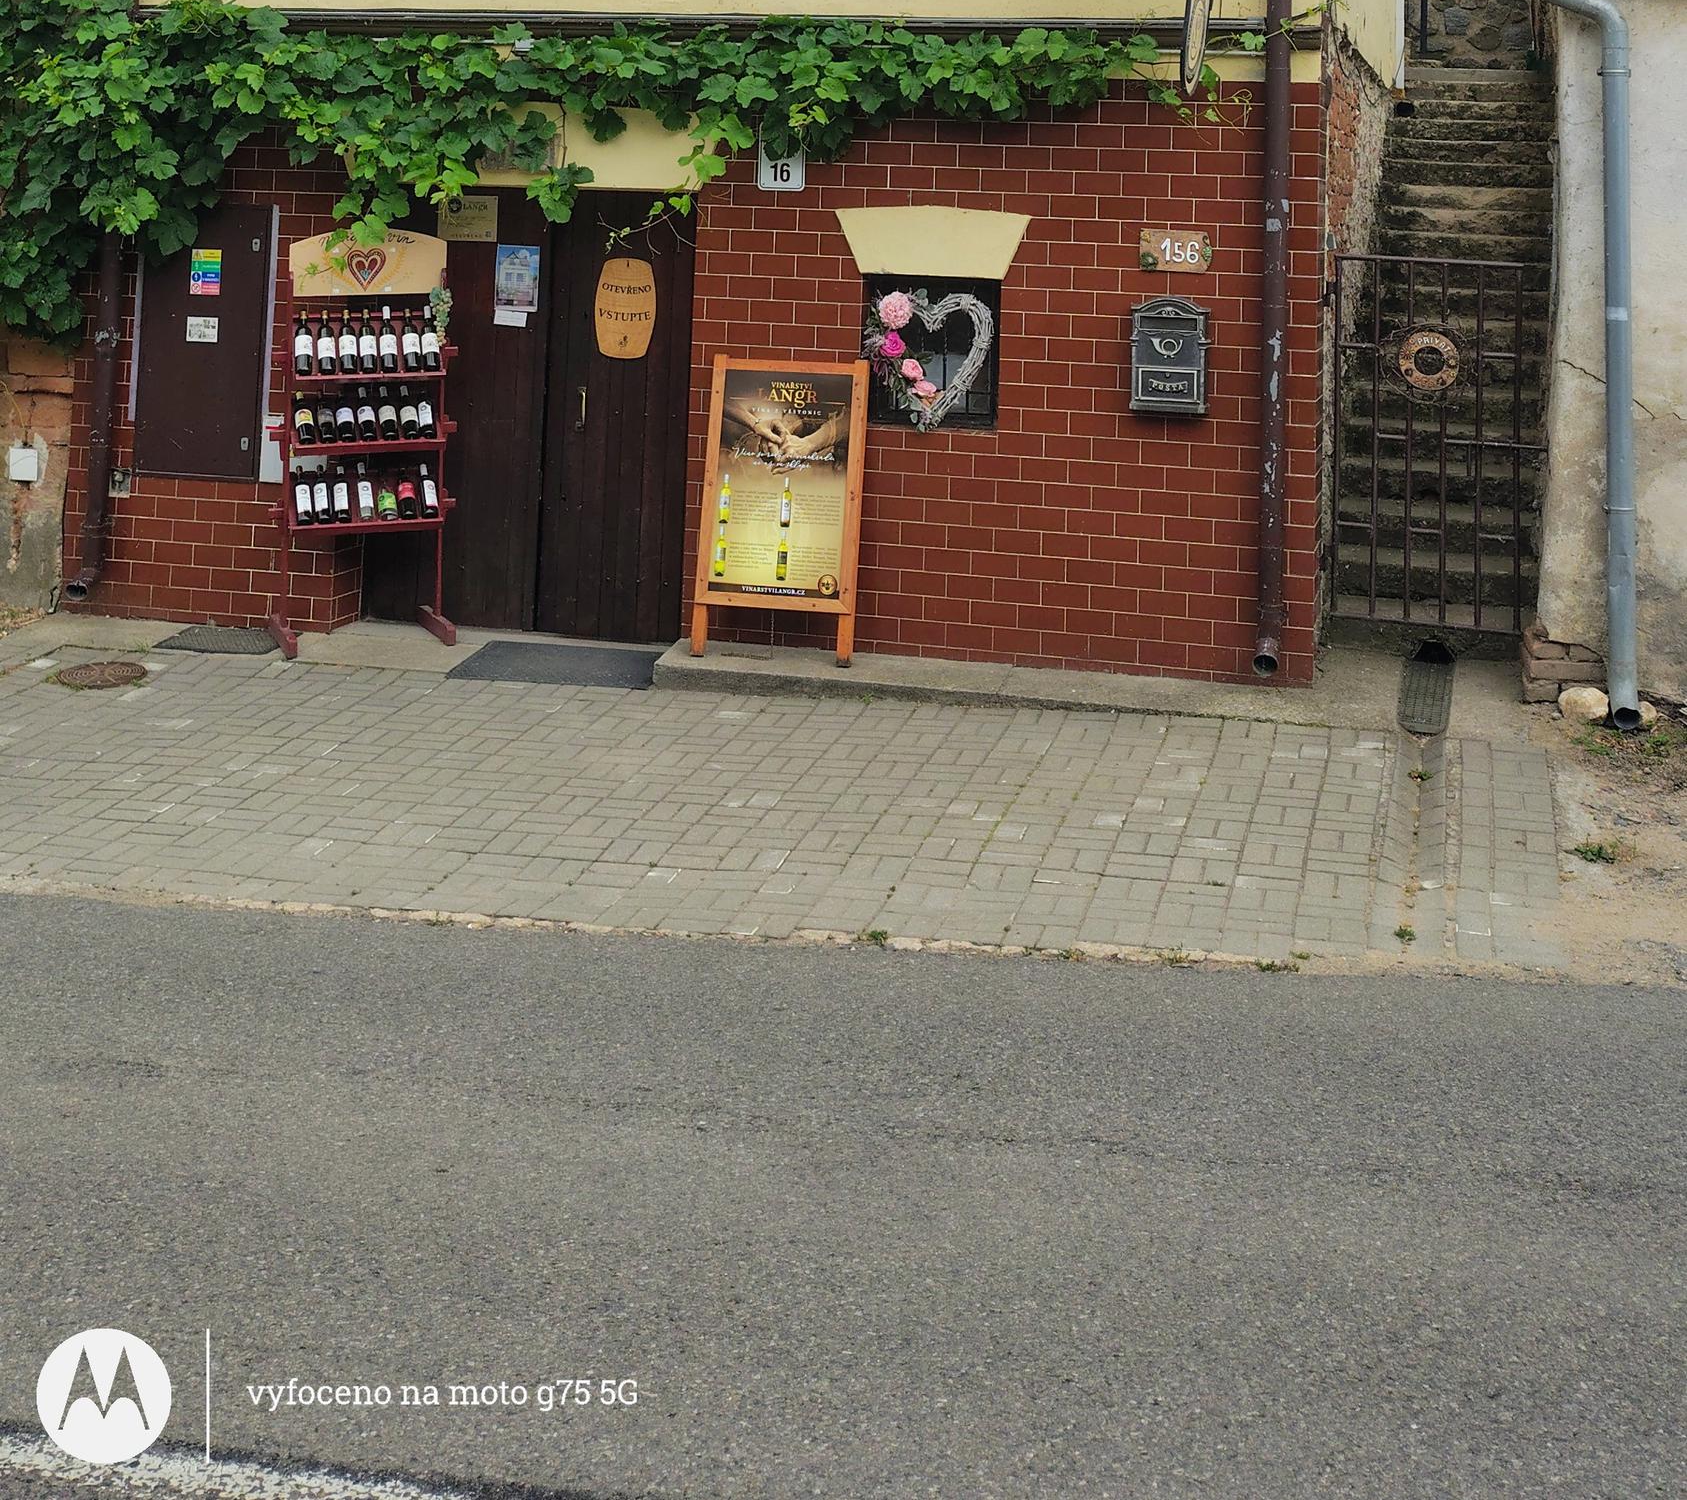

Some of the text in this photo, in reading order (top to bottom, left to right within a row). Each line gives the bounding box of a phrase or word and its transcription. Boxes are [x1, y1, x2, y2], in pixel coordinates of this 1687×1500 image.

[770, 162, 791, 183] 16
[1160, 237, 1200, 264] 156
[601, 282, 652, 295] OTEVŘENO
[599, 307, 652, 322] VSTUPTE
